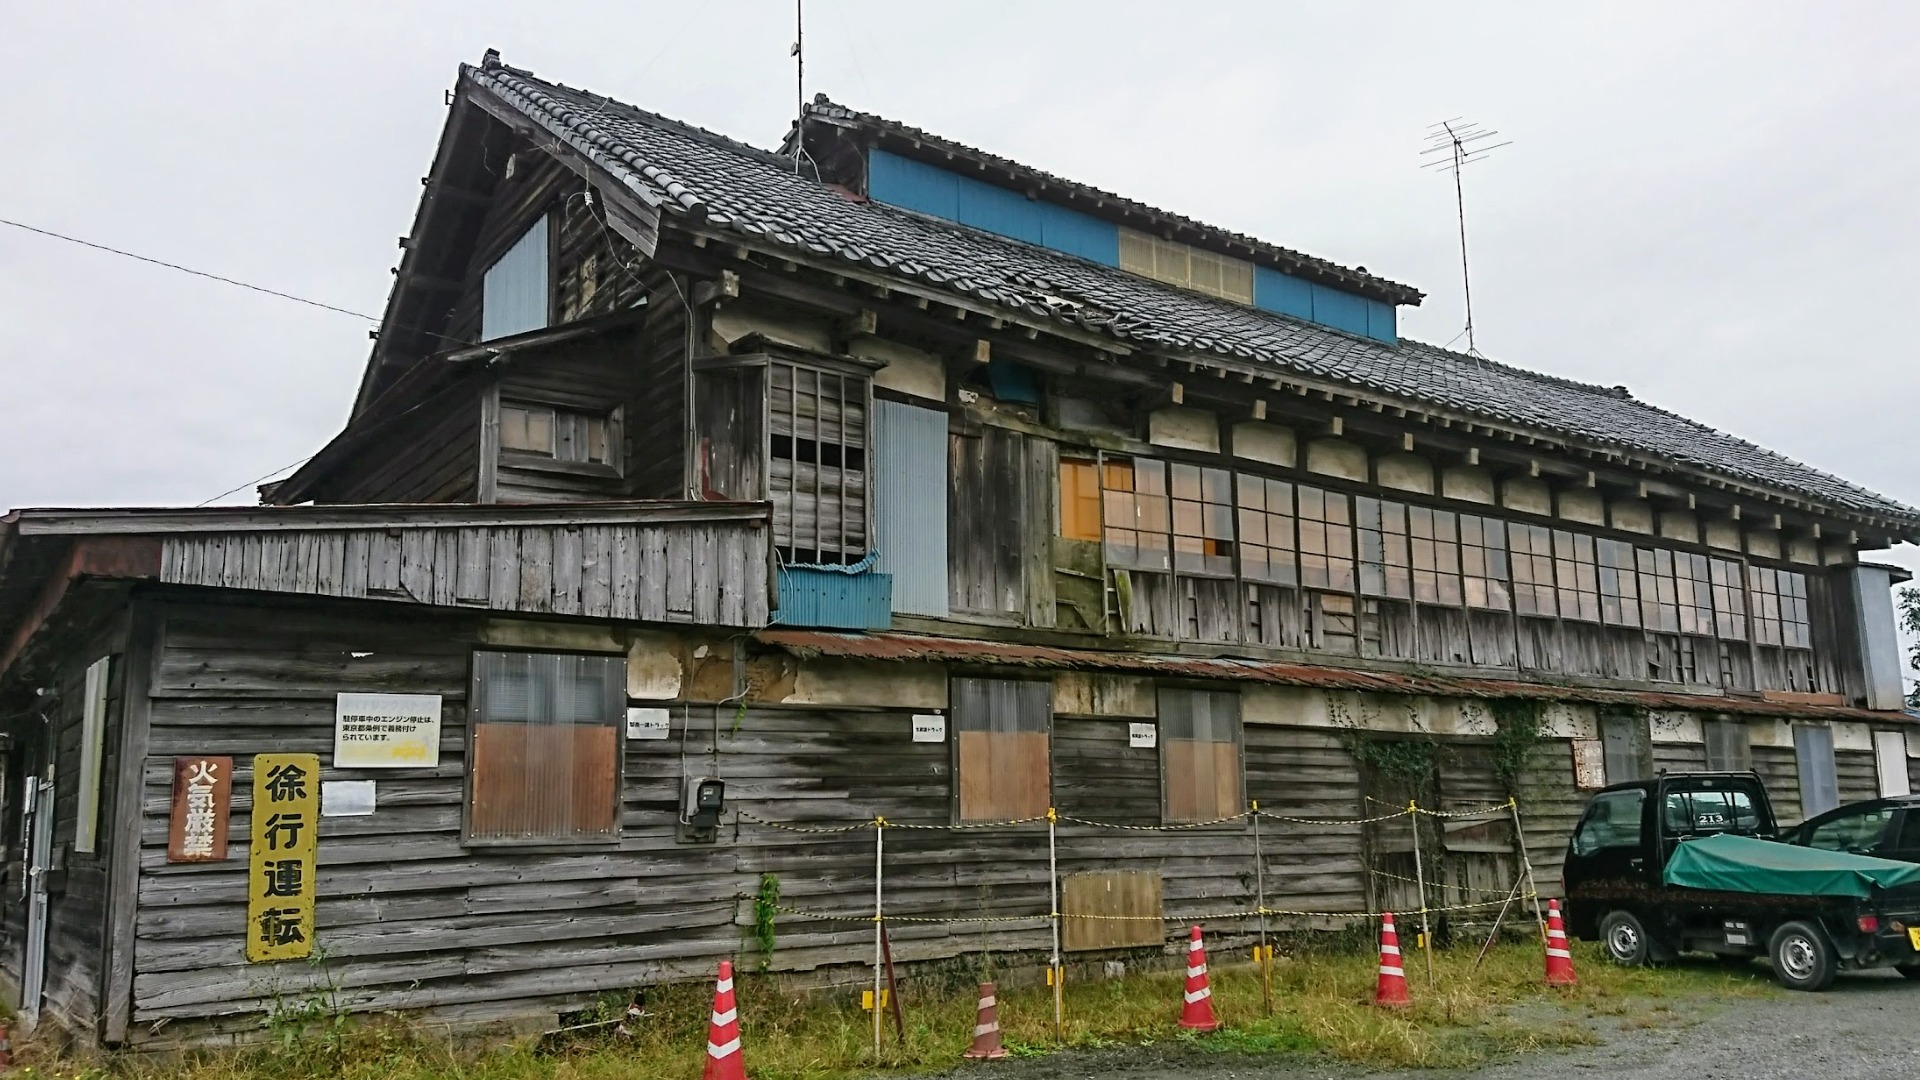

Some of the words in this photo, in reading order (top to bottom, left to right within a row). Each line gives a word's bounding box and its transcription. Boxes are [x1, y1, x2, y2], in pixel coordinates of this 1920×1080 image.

[342, 715, 435, 724] 駐停車中のエンジン停止は、
[342, 724, 417, 732] 東京都条例で義務付け
[183, 760, 218, 857] 火気厳禁
[1699, 814, 1724, 823] 213
[260, 764, 307, 947] 徐行運転
